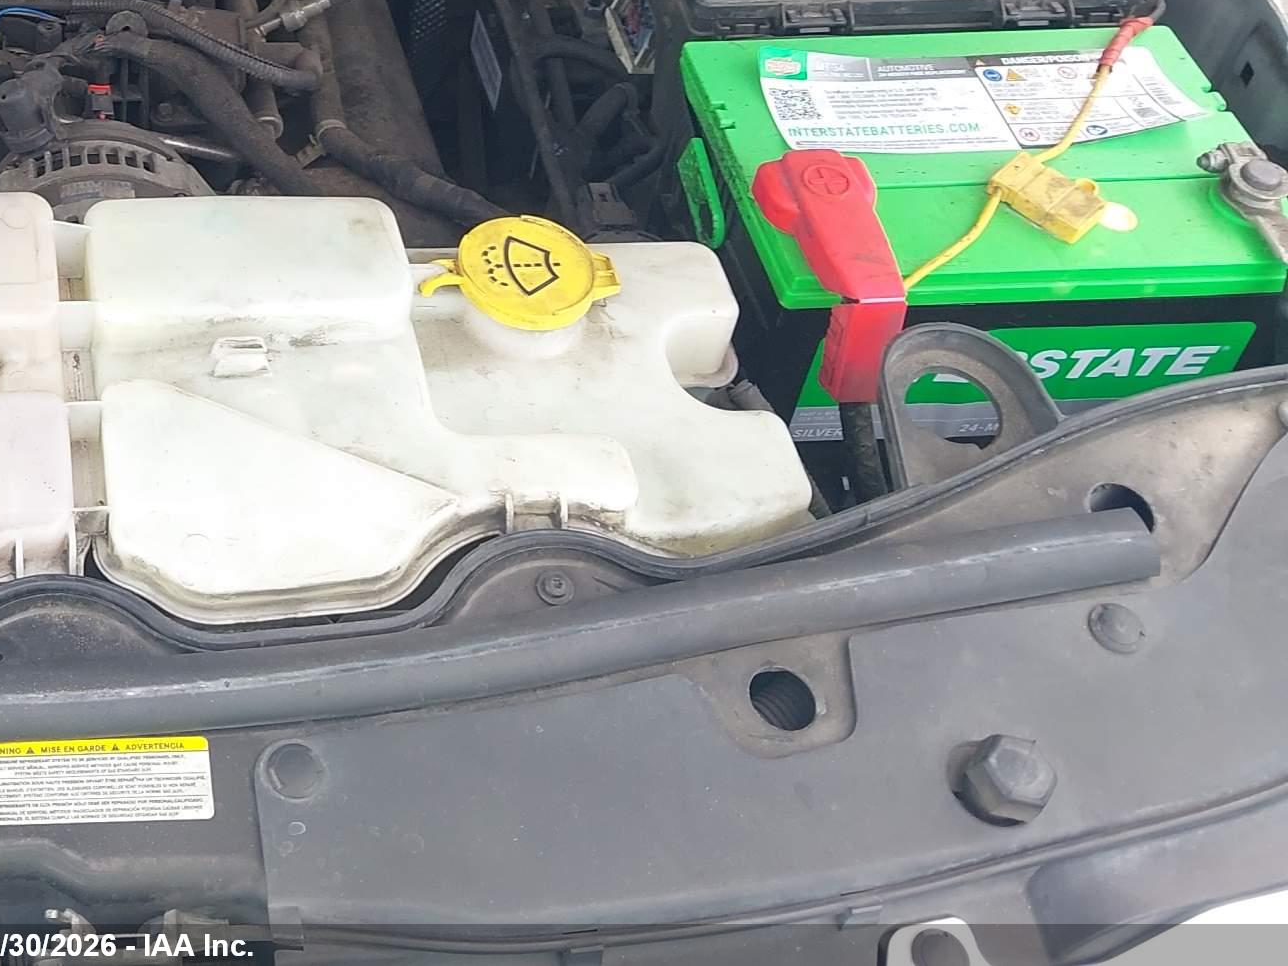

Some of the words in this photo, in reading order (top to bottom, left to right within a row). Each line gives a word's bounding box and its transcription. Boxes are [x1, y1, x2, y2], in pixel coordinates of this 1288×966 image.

[788, 123, 980, 137] INTERSTATEBATTERIES.COM
[1016, 345, 1220, 379] STATE
[792, 427, 843, 438] SILVER
[40, 745, 61, 754] MISE
[64, 745, 75, 753] EN
[77, 744, 106, 753] GARDE
[125, 742, 185, 751] ADVERTENCIA
